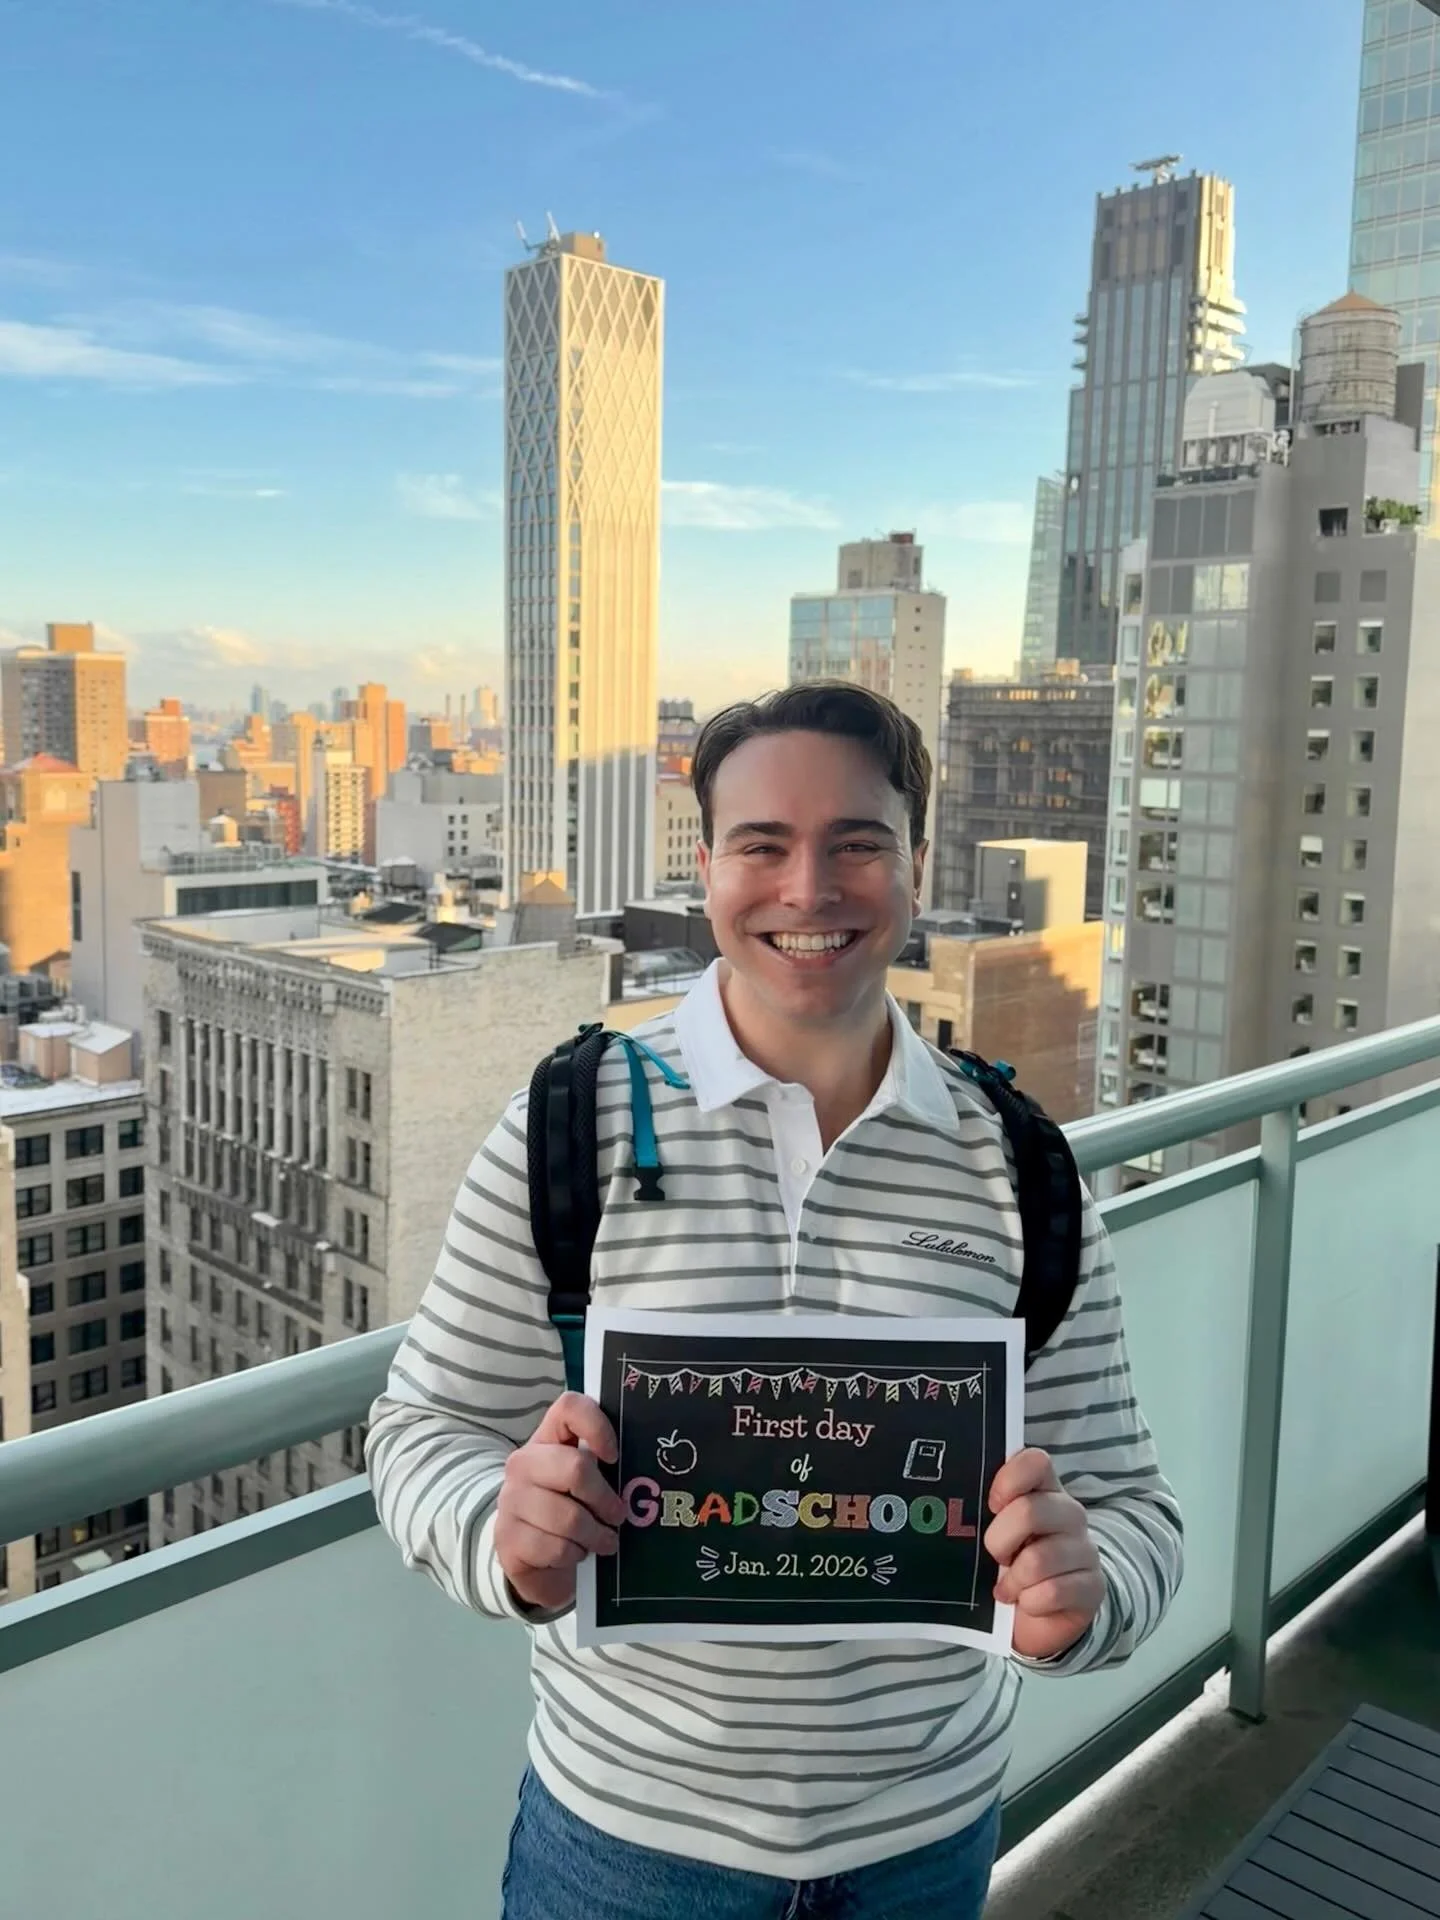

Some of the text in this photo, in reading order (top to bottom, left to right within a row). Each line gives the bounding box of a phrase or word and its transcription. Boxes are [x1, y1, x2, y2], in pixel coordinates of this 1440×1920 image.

[902, 1231, 996, 1263] Lululemon
[731, 1405, 875, 1446] First day
[790, 1453, 813, 1482] of
[724, 1551, 868, 1578] Jan. 21, 2026
